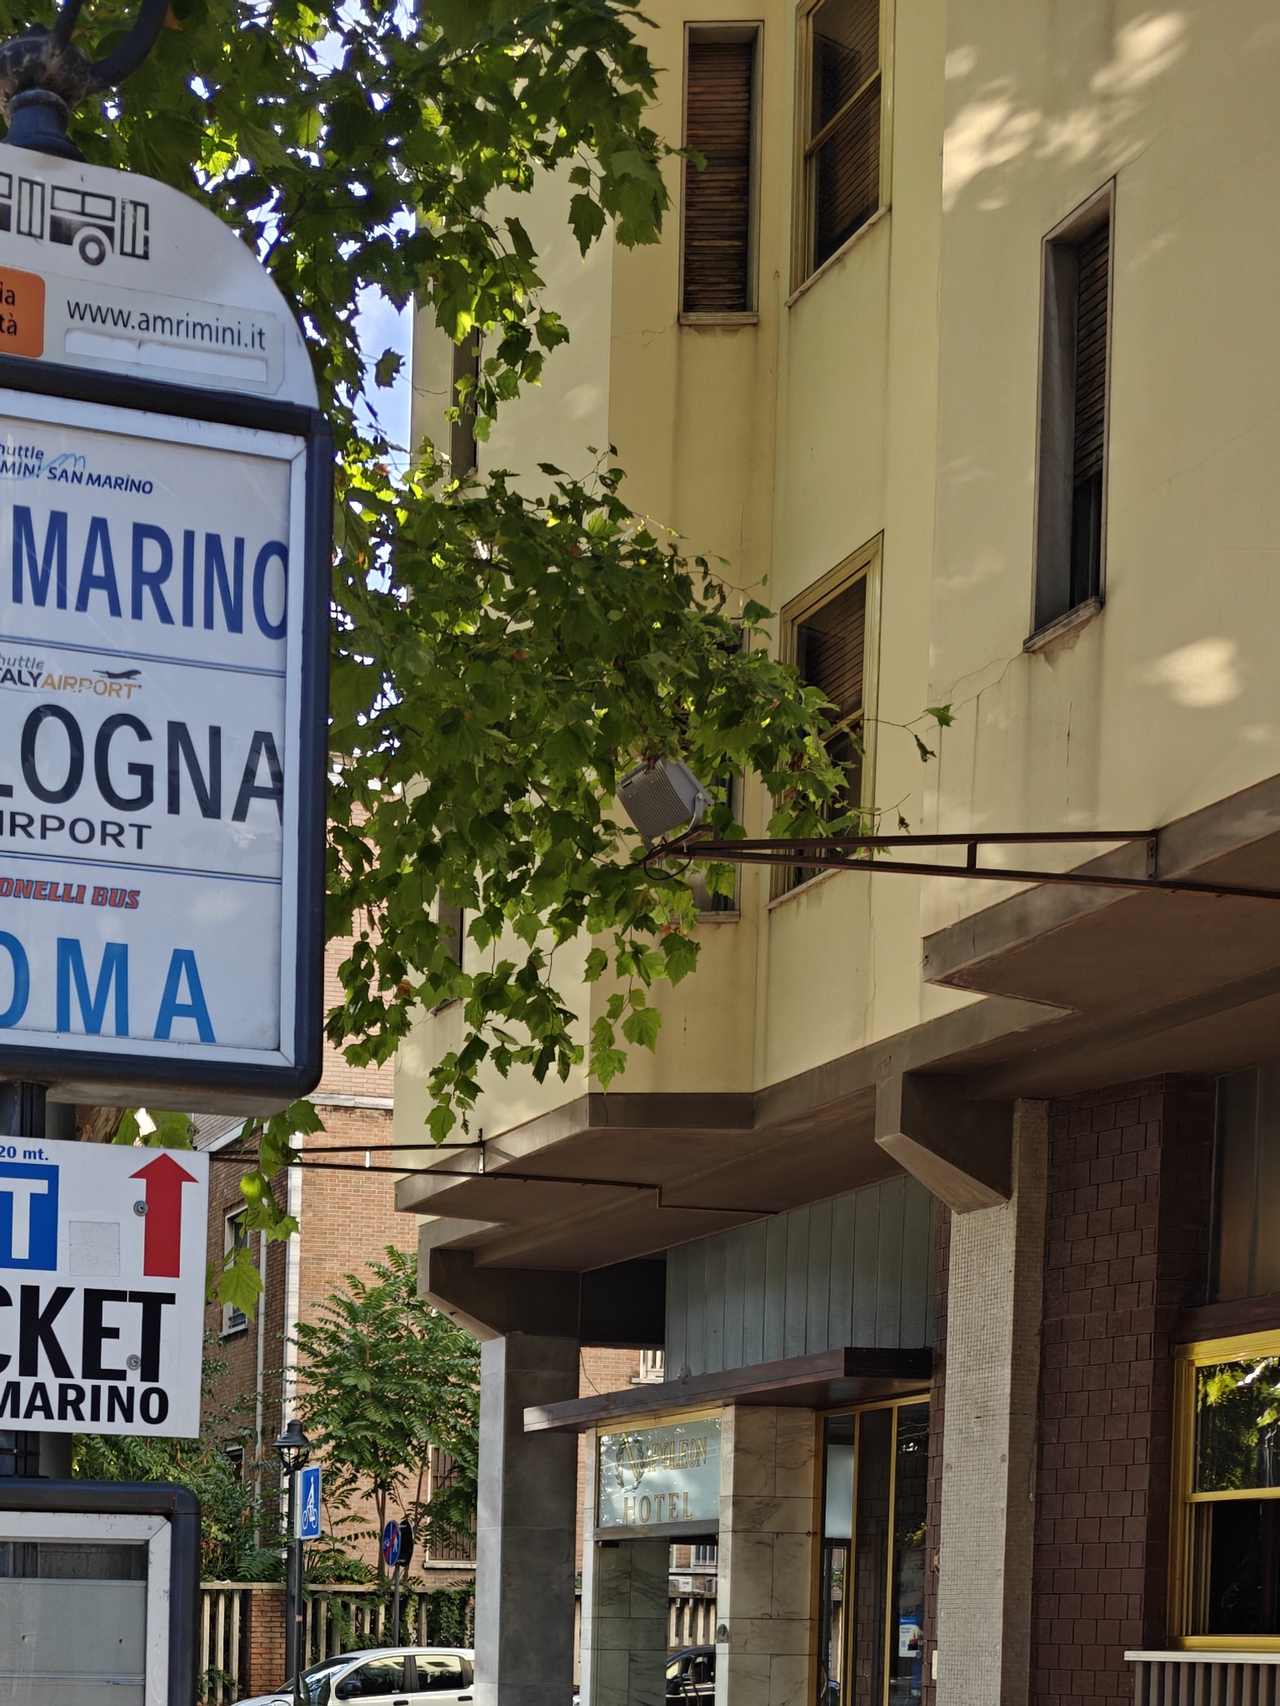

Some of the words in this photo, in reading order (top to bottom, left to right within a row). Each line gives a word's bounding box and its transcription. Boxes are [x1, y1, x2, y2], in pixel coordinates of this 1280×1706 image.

[67, 301, 266, 351] www.amrimini.it
[47, 465, 84, 486] SAN
[86, 471, 153, 494] MARINO
[12, 505, 288, 641] MARINO
[92, 886, 141, 910] BUS
[23, 1147, 49, 1161] mt.
[620, 1432, 708, 1486] NAPOLEON
[623, 1492, 693, 1525] HOTEL
